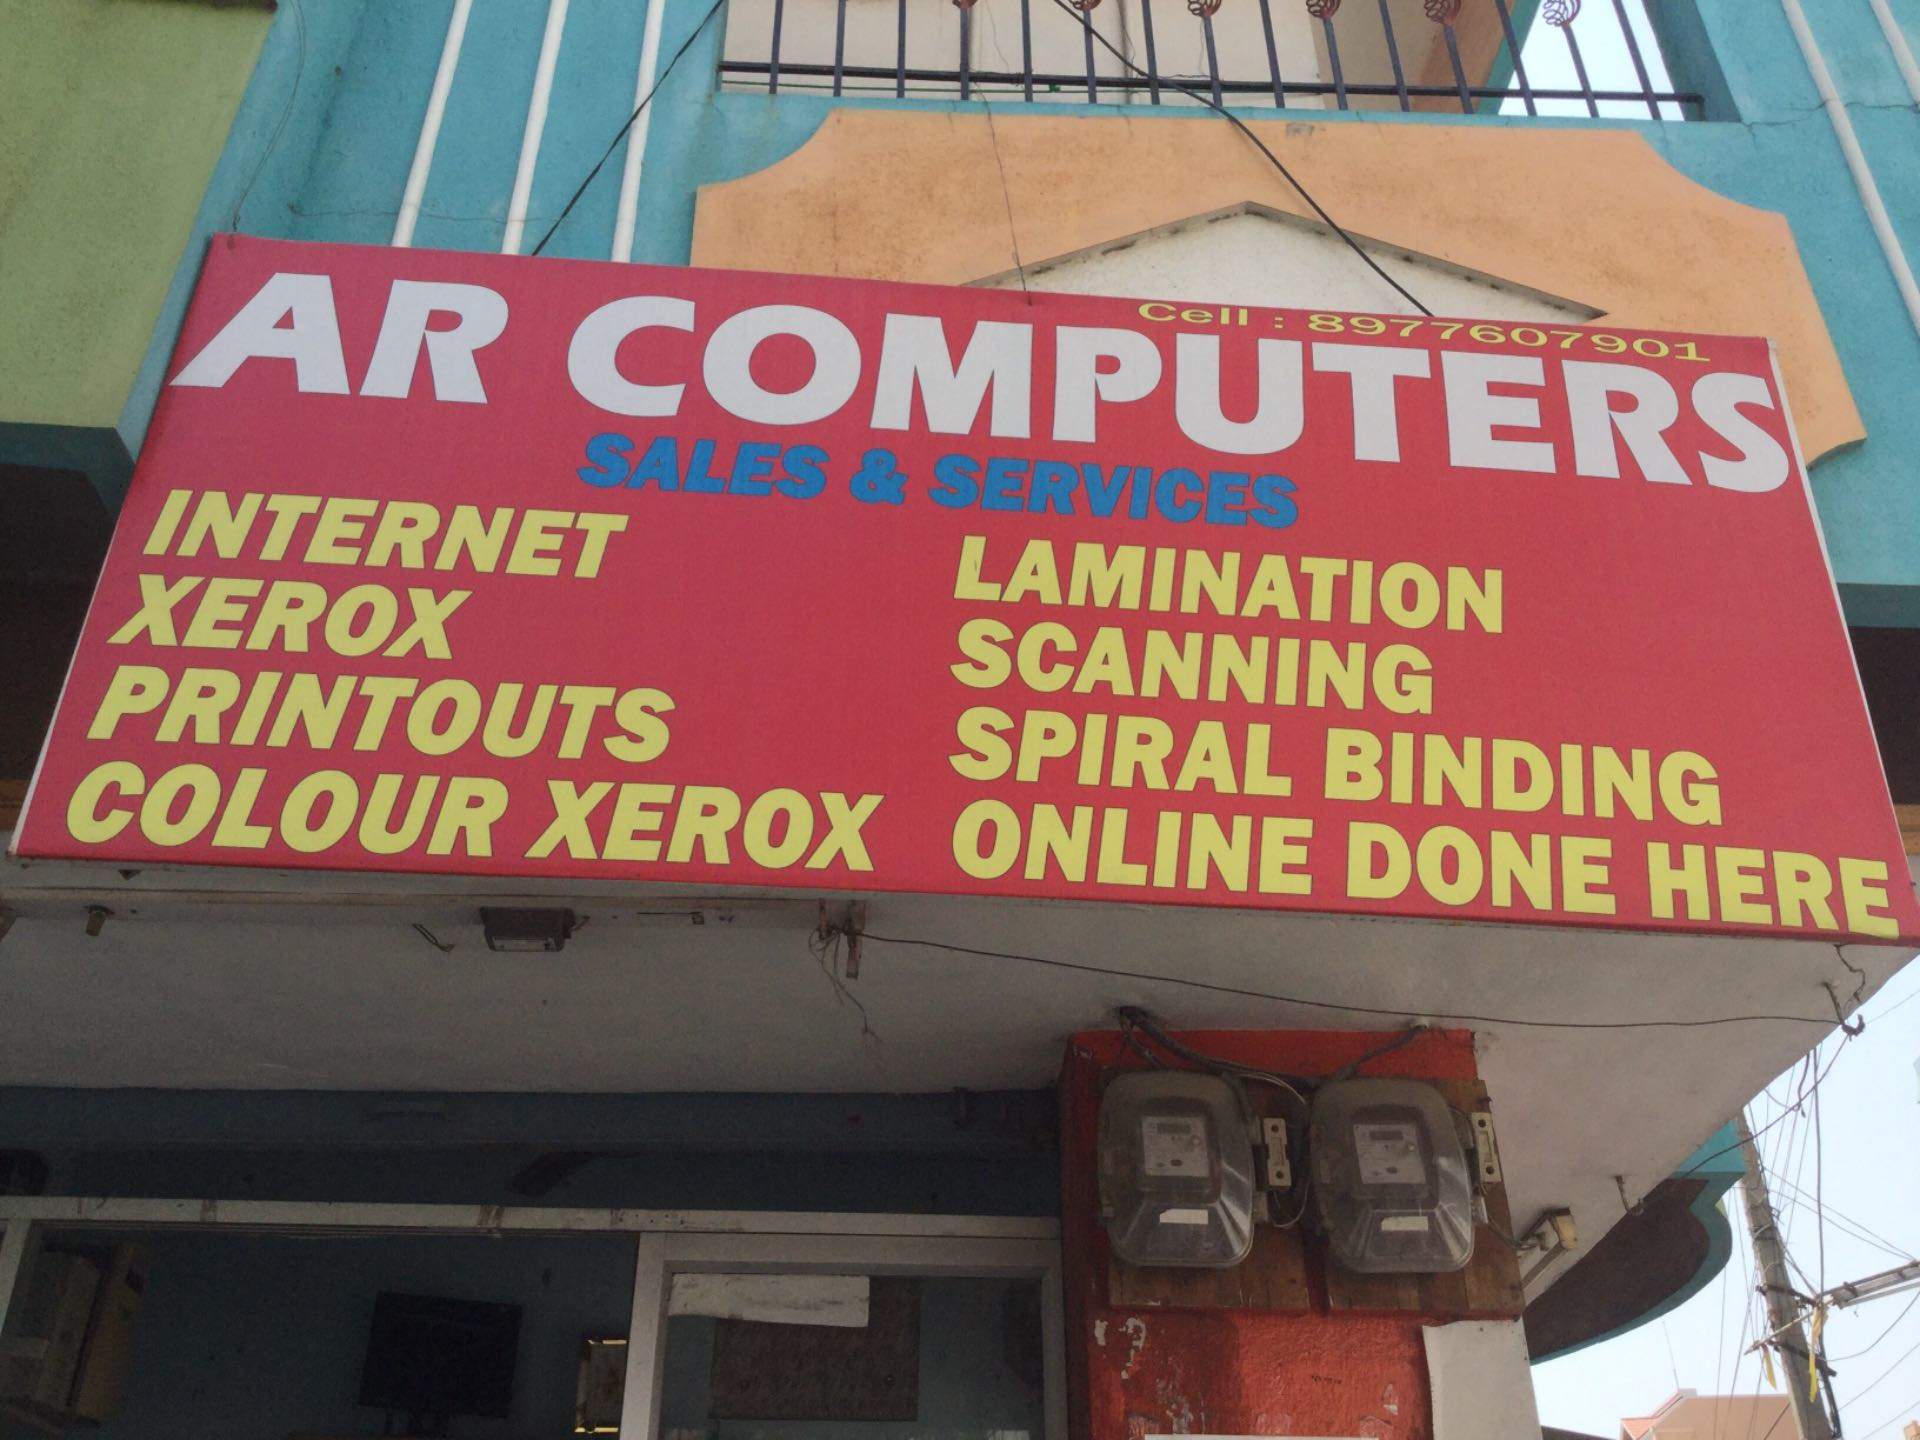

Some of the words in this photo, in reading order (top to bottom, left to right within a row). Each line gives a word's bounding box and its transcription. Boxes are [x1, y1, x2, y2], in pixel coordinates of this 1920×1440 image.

[1138, 302, 1248, 326] Cell
[1308, 313, 1711, 362] 8977607901
[170, 272, 509, 404] AR
[567, 295, 1789, 493] COMPUTERS
[578, 433, 828, 499] SALES
[850, 448, 908, 505] &
[929, 454, 1298, 529] SERVICES
[143, 489, 629, 578] INTERNET
[107, 573, 473, 660] XEROX
[953, 535, 1503, 634] LAMINATION
[87, 665, 676, 763] PRINTOUTS
[950, 618, 1433, 715] SCANNING
[948, 706, 1292, 797] SPIRAL
[1324, 727, 1722, 826] BINDING
[66, 760, 509, 857] COLOUR
[524, 779, 884, 872] XEROX
[952, 799, 1314, 895] ONLINE
[1346, 821, 1617, 915] DONE
[1646, 841, 1900, 939] HERE
